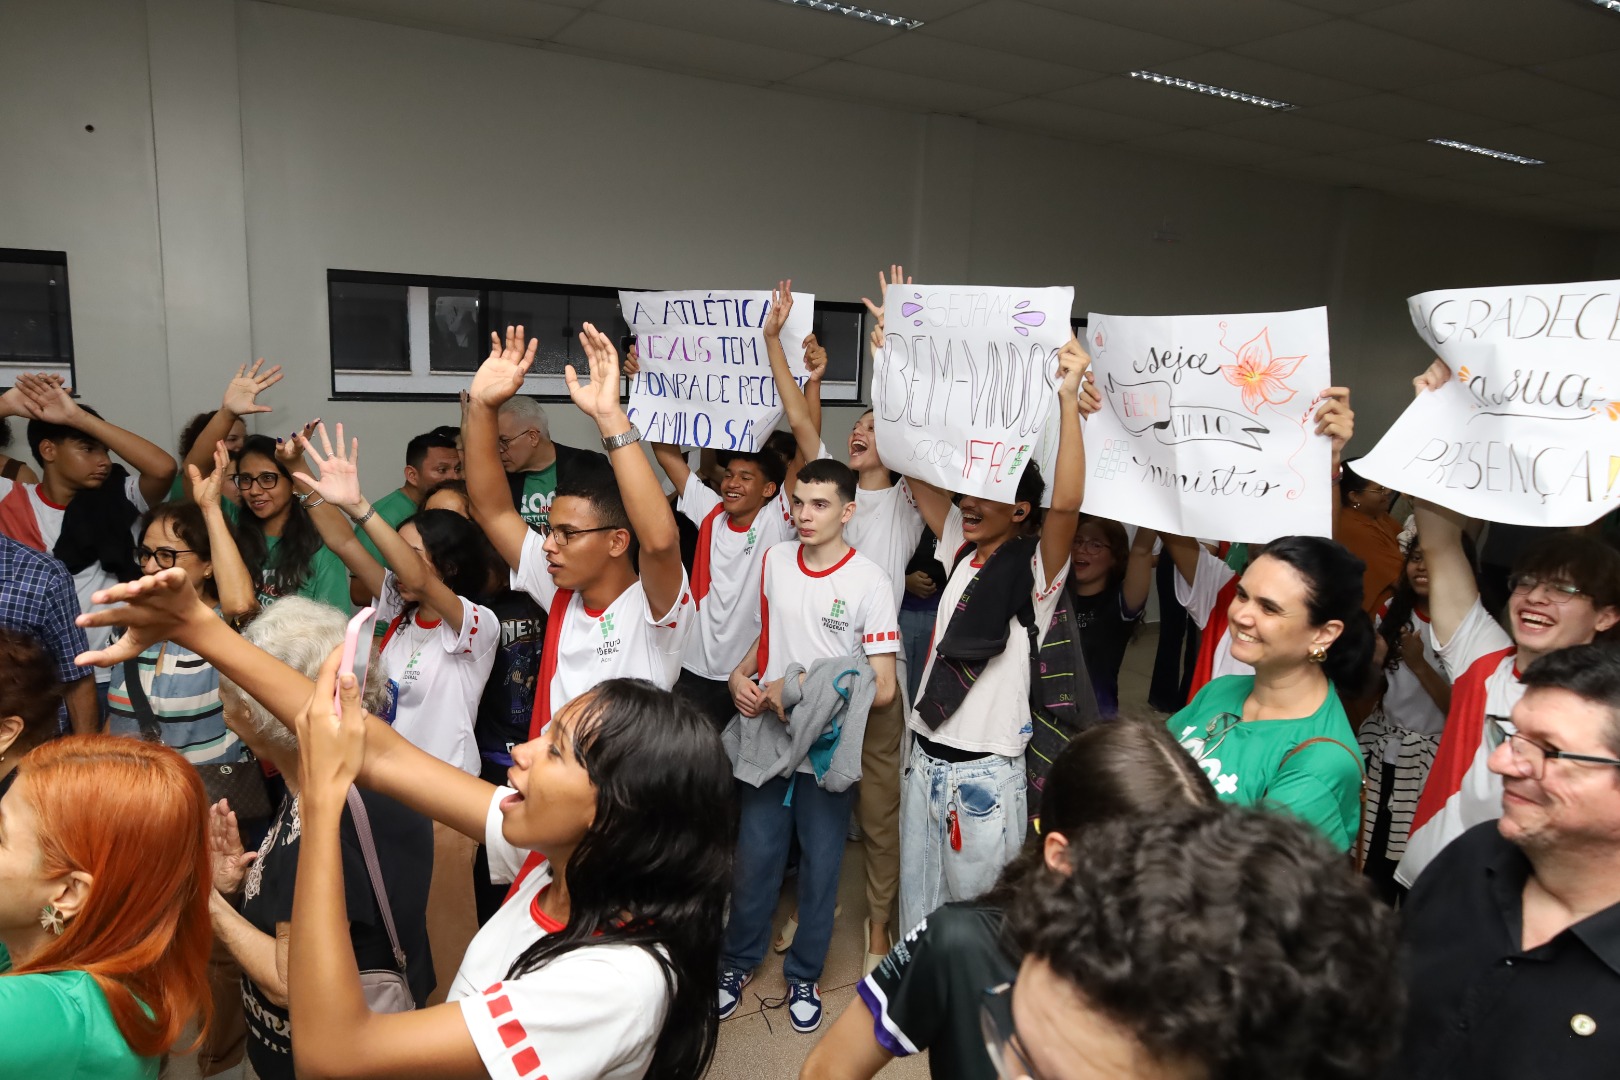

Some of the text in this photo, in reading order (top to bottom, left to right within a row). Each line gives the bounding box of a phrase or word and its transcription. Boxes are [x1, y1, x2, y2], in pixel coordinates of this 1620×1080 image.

[633, 301, 655, 325] A
[926, 293, 1011, 328] SEJAM
[634, 335, 759, 366] NEXUS TEM
[1133, 346, 1221, 385] seja
[634, 372, 704, 402] HONRA
[706, 374, 730, 403] DE
[1123, 392, 1158, 417] BEM
[1132, 456, 1280, 498] ministro
